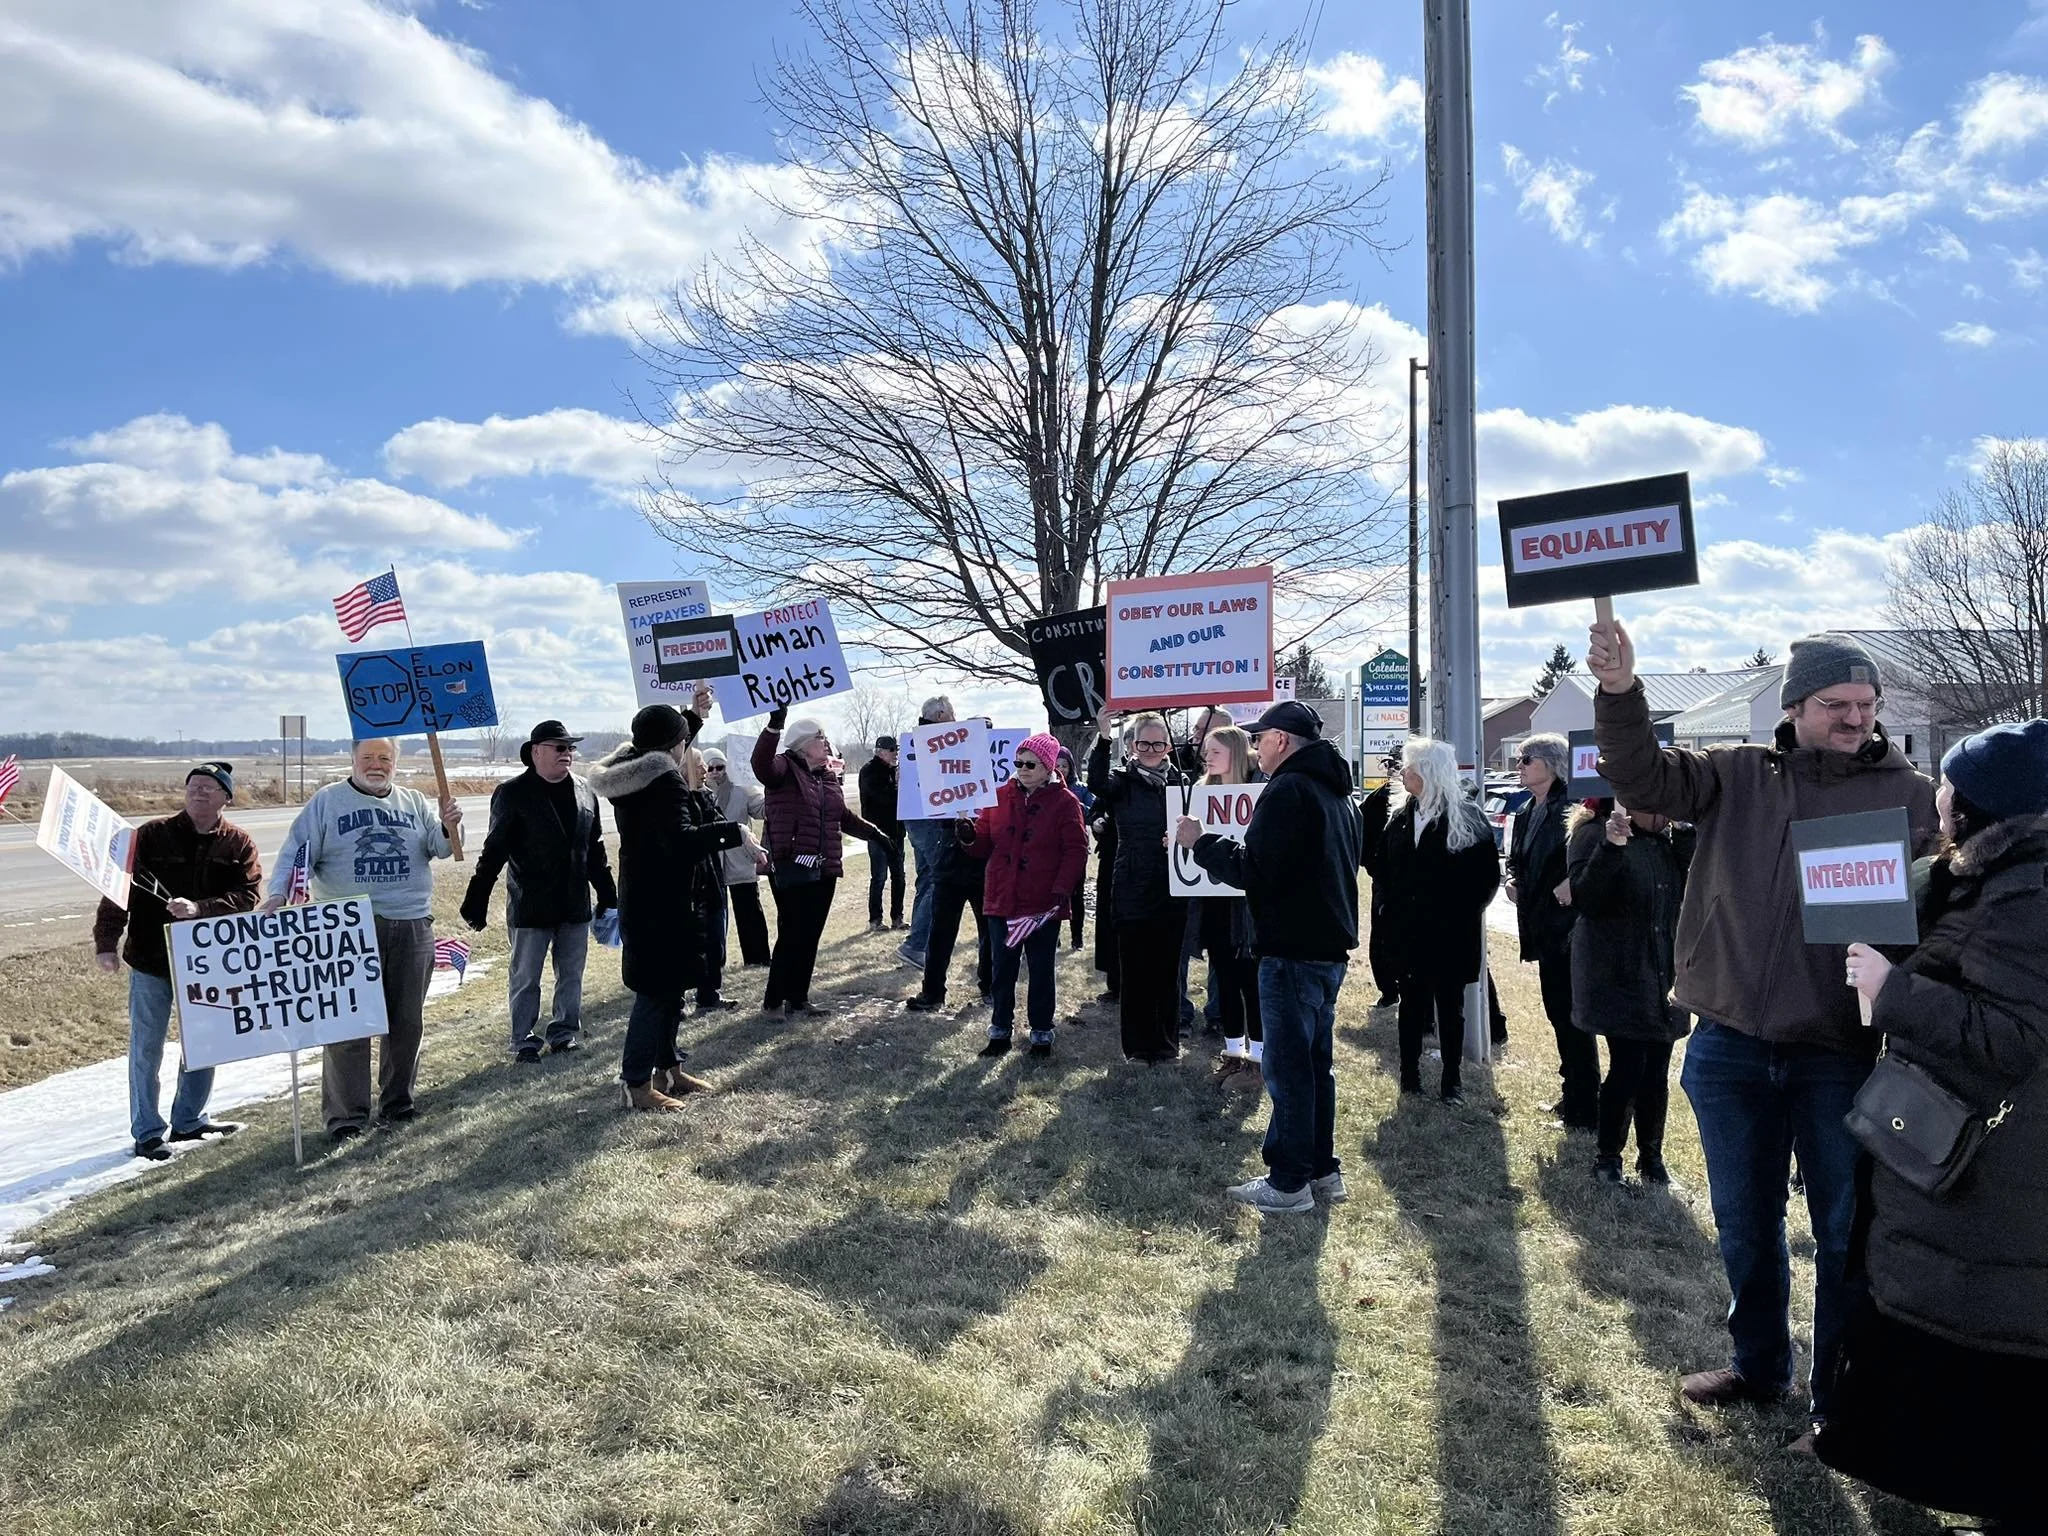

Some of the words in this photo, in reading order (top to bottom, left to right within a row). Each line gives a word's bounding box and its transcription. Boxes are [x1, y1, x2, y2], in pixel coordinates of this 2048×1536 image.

[1521, 518, 1671, 561] EQUALITY
[628, 586, 692, 609] REPRESENT
[1118, 605, 1164, 621] OBEY
[1166, 601, 1204, 618] OUR
[1208, 597, 1258, 614] LAWS
[629, 602, 706, 629] TAXPAYERS
[763, 600, 819, 629] PROTECT
[1031, 618, 1106, 643] CONSTITU
[1149, 633, 1185, 653] AND
[1187, 624, 1226, 645] OUR
[663, 637, 728, 657] FREEDOM
[412, 659, 474, 679] ELON
[1117, 659, 1248, 681] CONSTITUTION
[352, 681, 409, 707] STOP
[742, 663, 835, 709] Rights
[423, 713, 454, 730] 47
[1380, 712, 1406, 721] NAILS
[926, 727, 969, 754] STOP
[938, 759, 972, 775] THE
[337, 808, 374, 836] GRAND
[374, 807, 417, 831] VALLEY
[354, 855, 411, 876] STATE
[1806, 858, 1898, 890] INTEGRITY
[354, 874, 411, 883] UNIVERSITY
[191, 901, 361, 949] CONGRESS
[186, 954, 210, 975] IS
[221, 928, 375, 975] CO-EQUAL
[186, 982, 243, 1007] NOT
[233, 990, 339, 1035] BITCH
